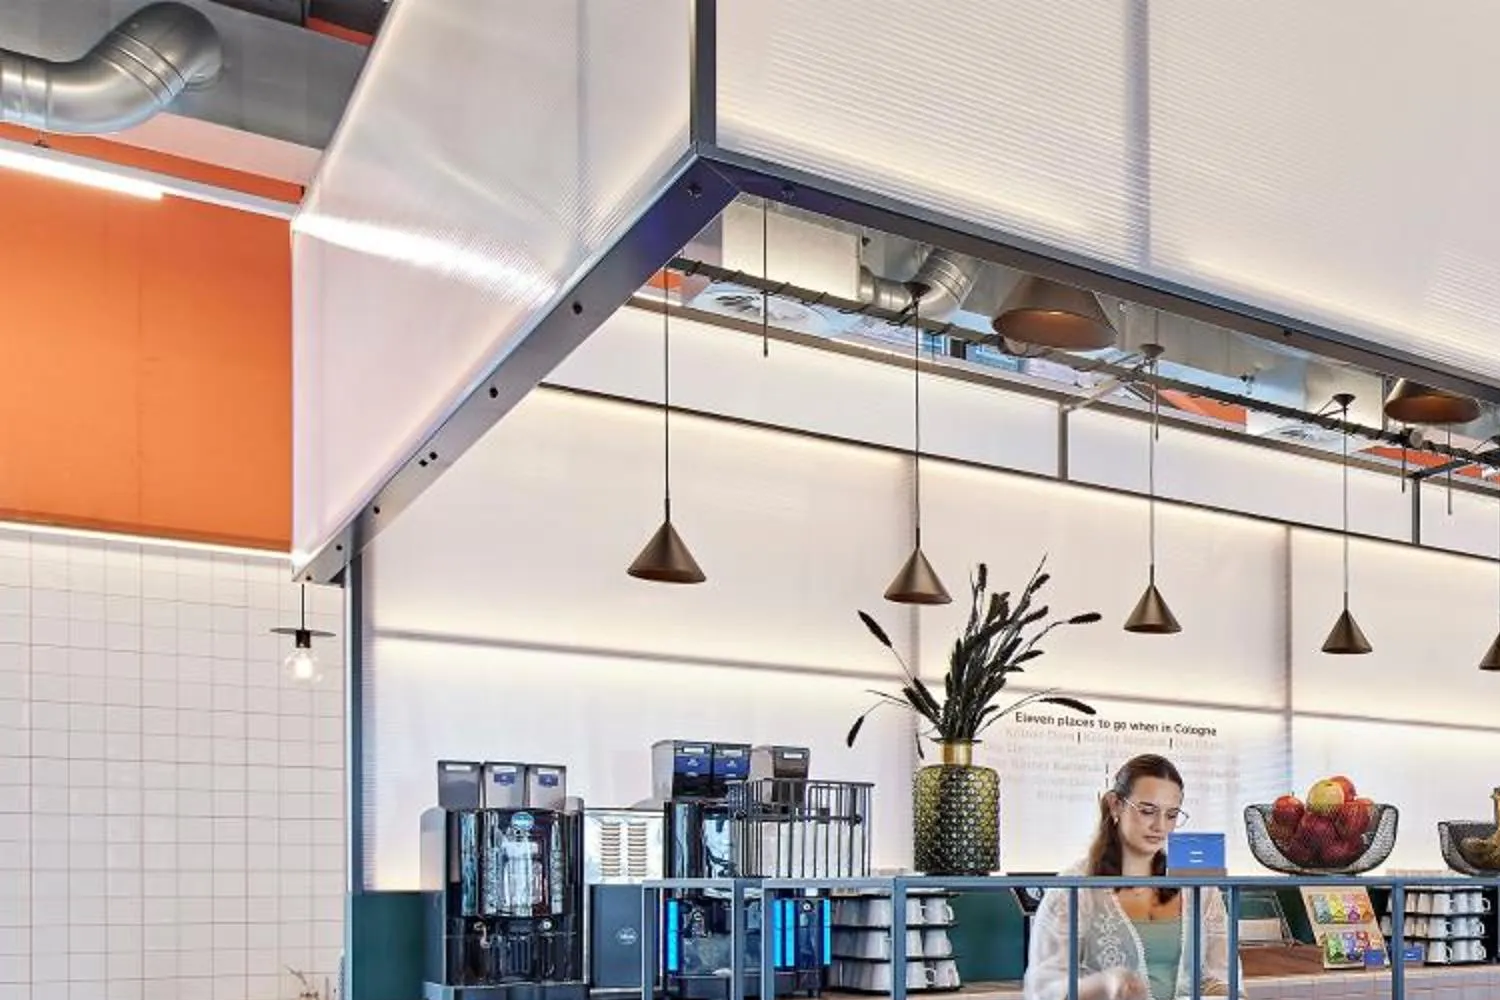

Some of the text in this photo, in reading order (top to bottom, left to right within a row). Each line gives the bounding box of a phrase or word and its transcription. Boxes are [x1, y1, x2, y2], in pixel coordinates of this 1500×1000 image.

[1015, 711, 1217, 737] Eleven places to go when in Cologne
